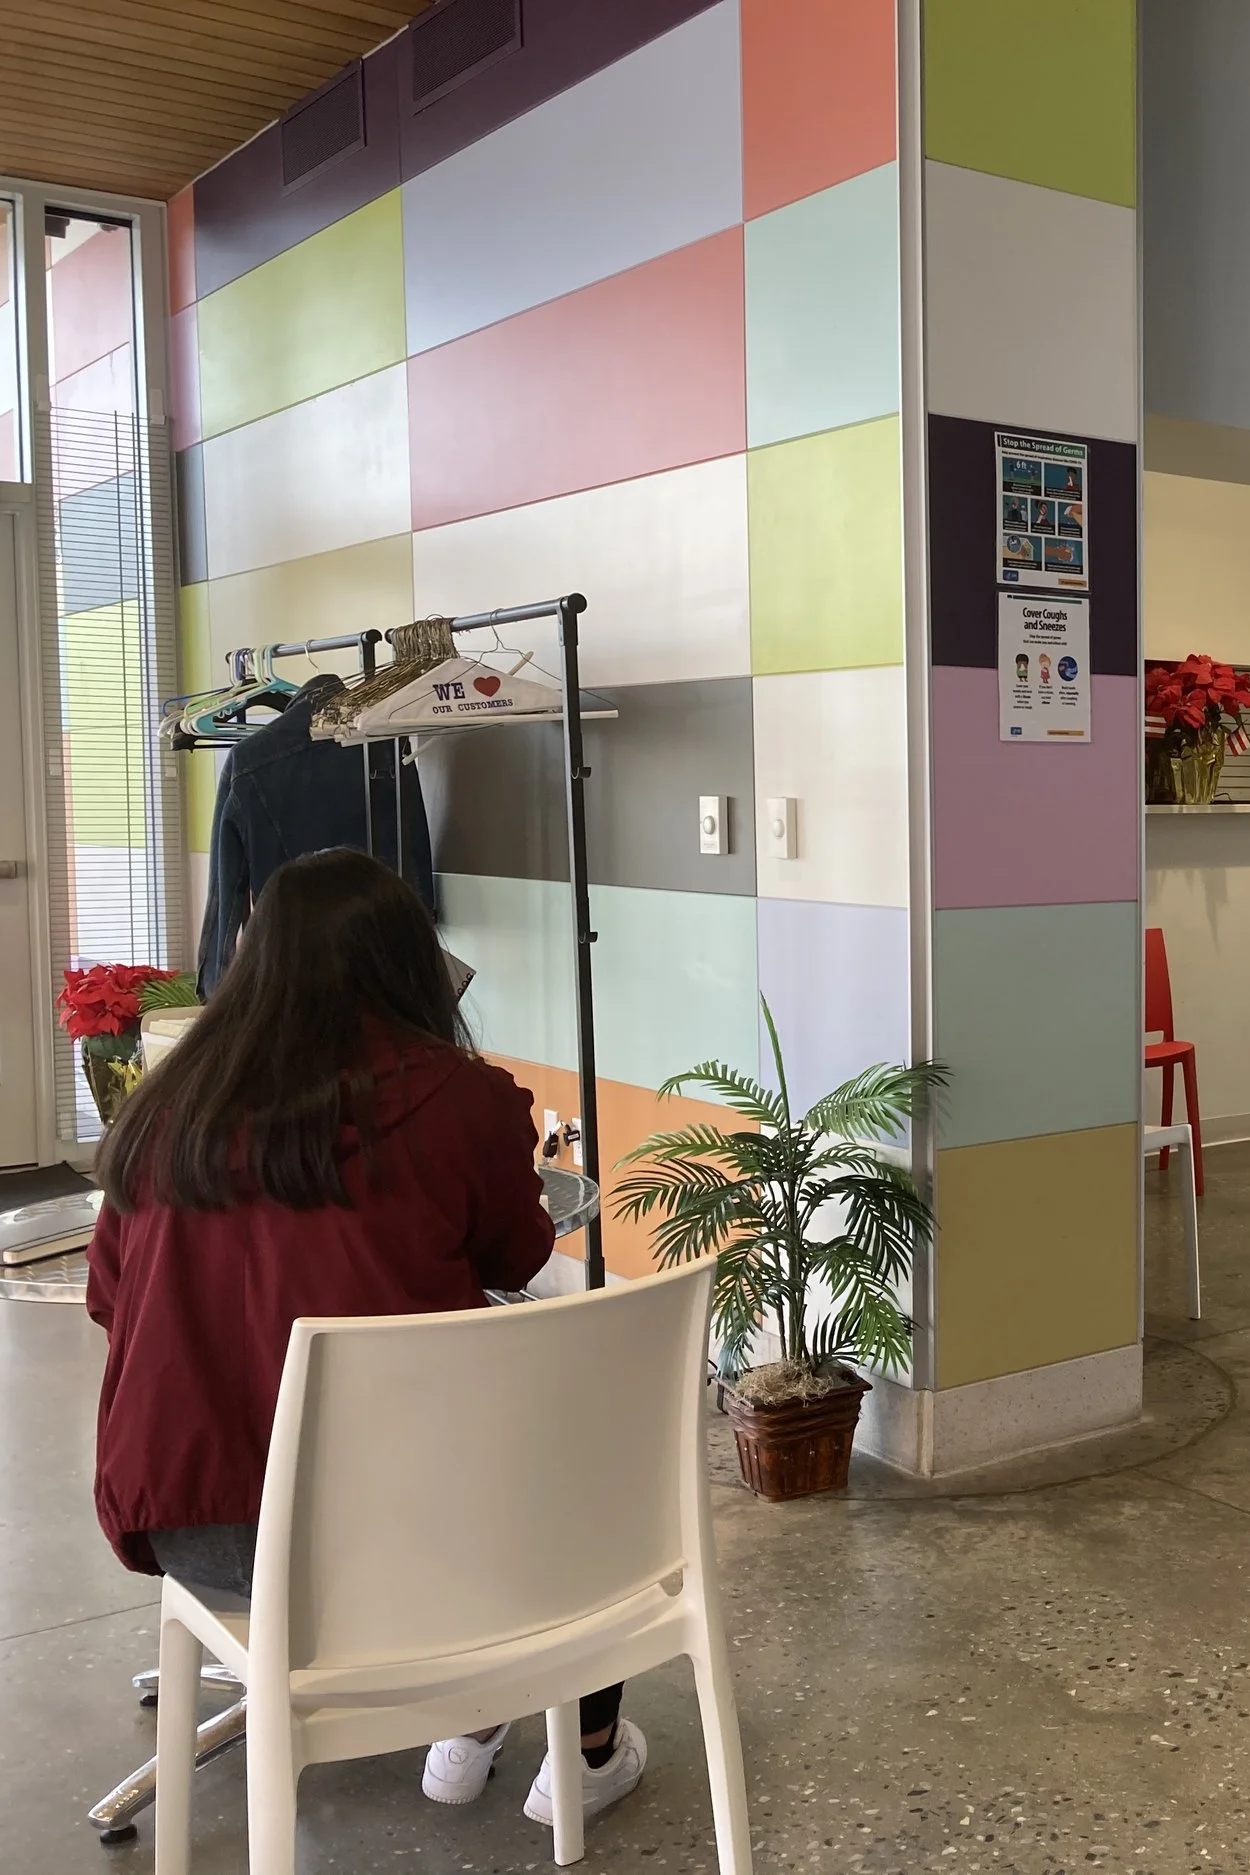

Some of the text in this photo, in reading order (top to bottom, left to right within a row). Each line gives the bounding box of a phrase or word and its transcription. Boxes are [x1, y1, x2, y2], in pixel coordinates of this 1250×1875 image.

[1003, 438, 1084, 456] Stop the Spread of Germs
[1016, 460, 1021, 469] 6
[1023, 607, 1068, 623] Cover Coughs
[1024, 620, 1066, 632] and Sneezes
[432, 682, 466, 701] WE
[432, 699, 513, 715] OUR CUSTOMERS
